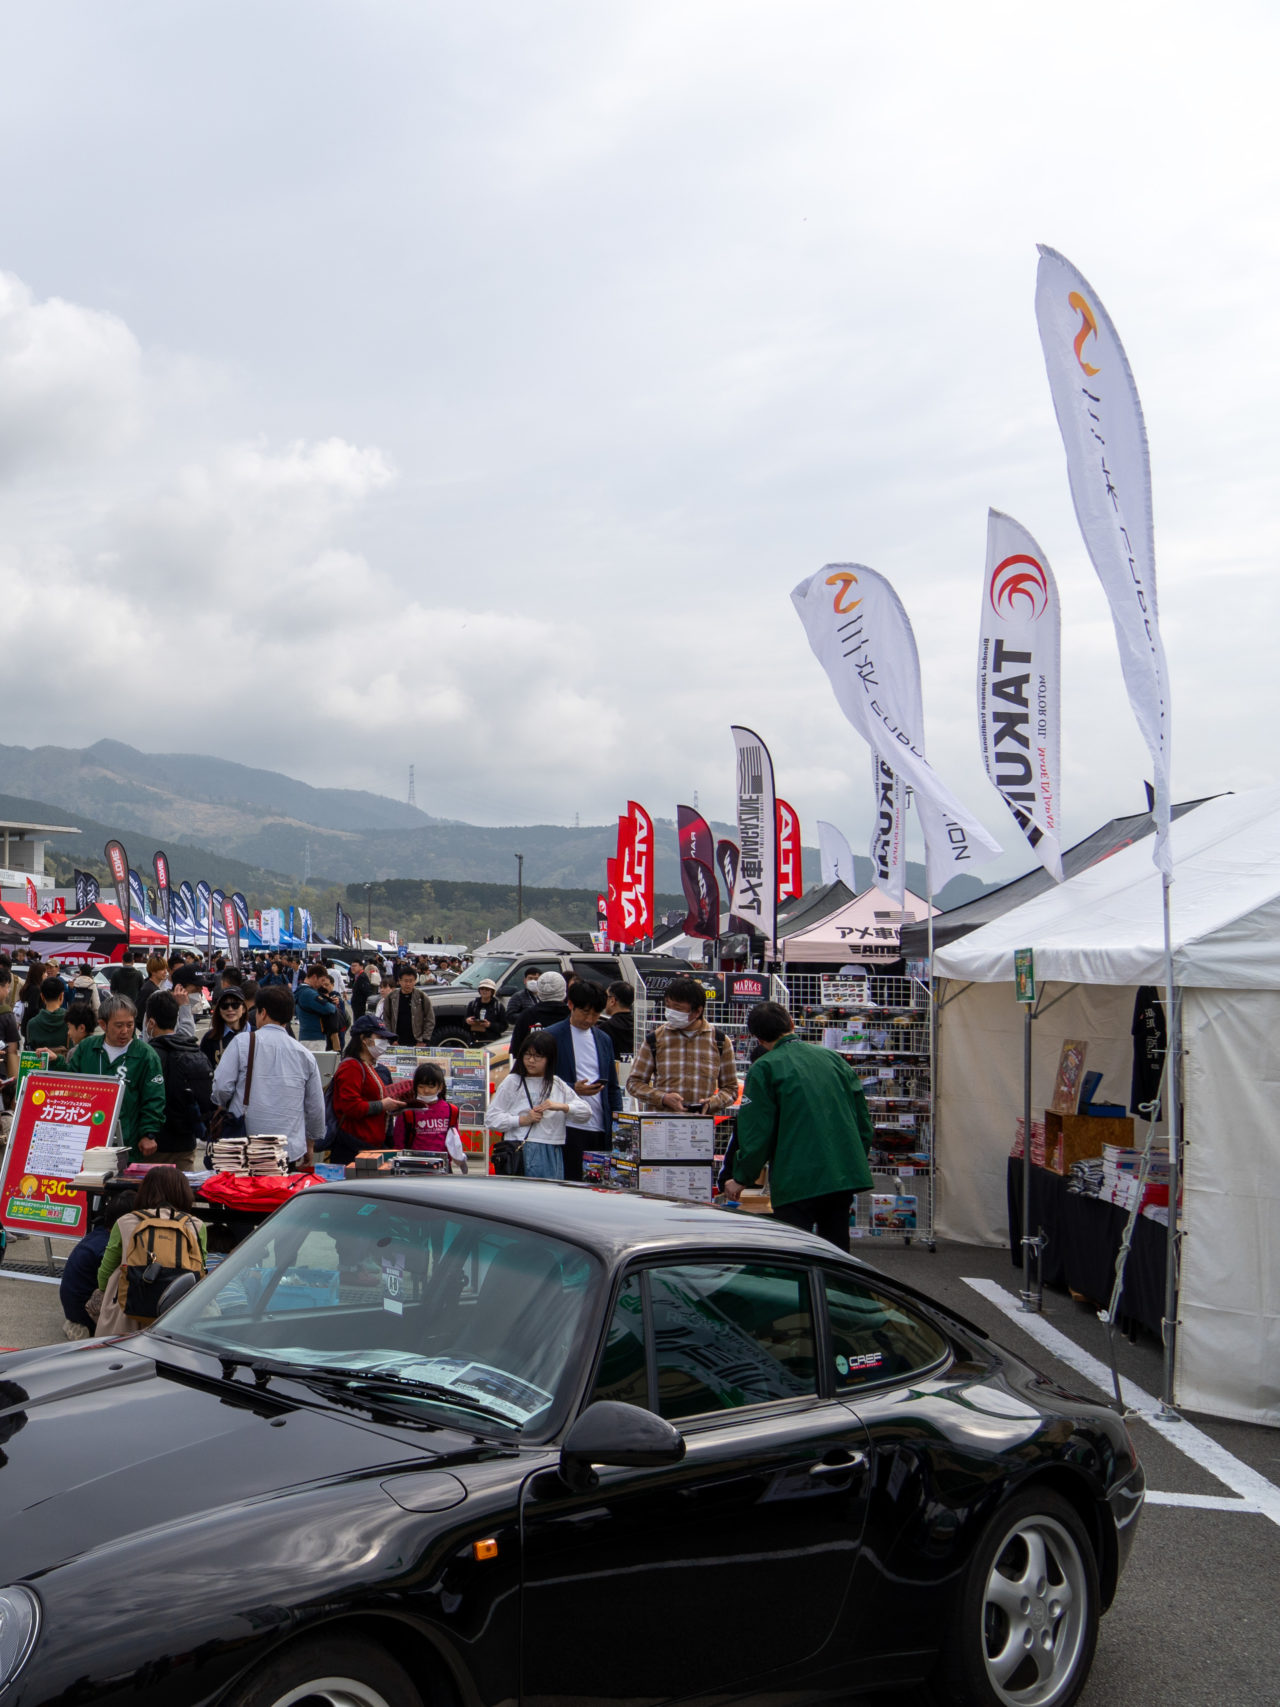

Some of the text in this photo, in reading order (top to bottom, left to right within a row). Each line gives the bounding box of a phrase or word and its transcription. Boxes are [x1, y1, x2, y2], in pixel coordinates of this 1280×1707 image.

[69, 919, 104, 927] TONE
[40, 1104, 92, 1123] ガラポン
